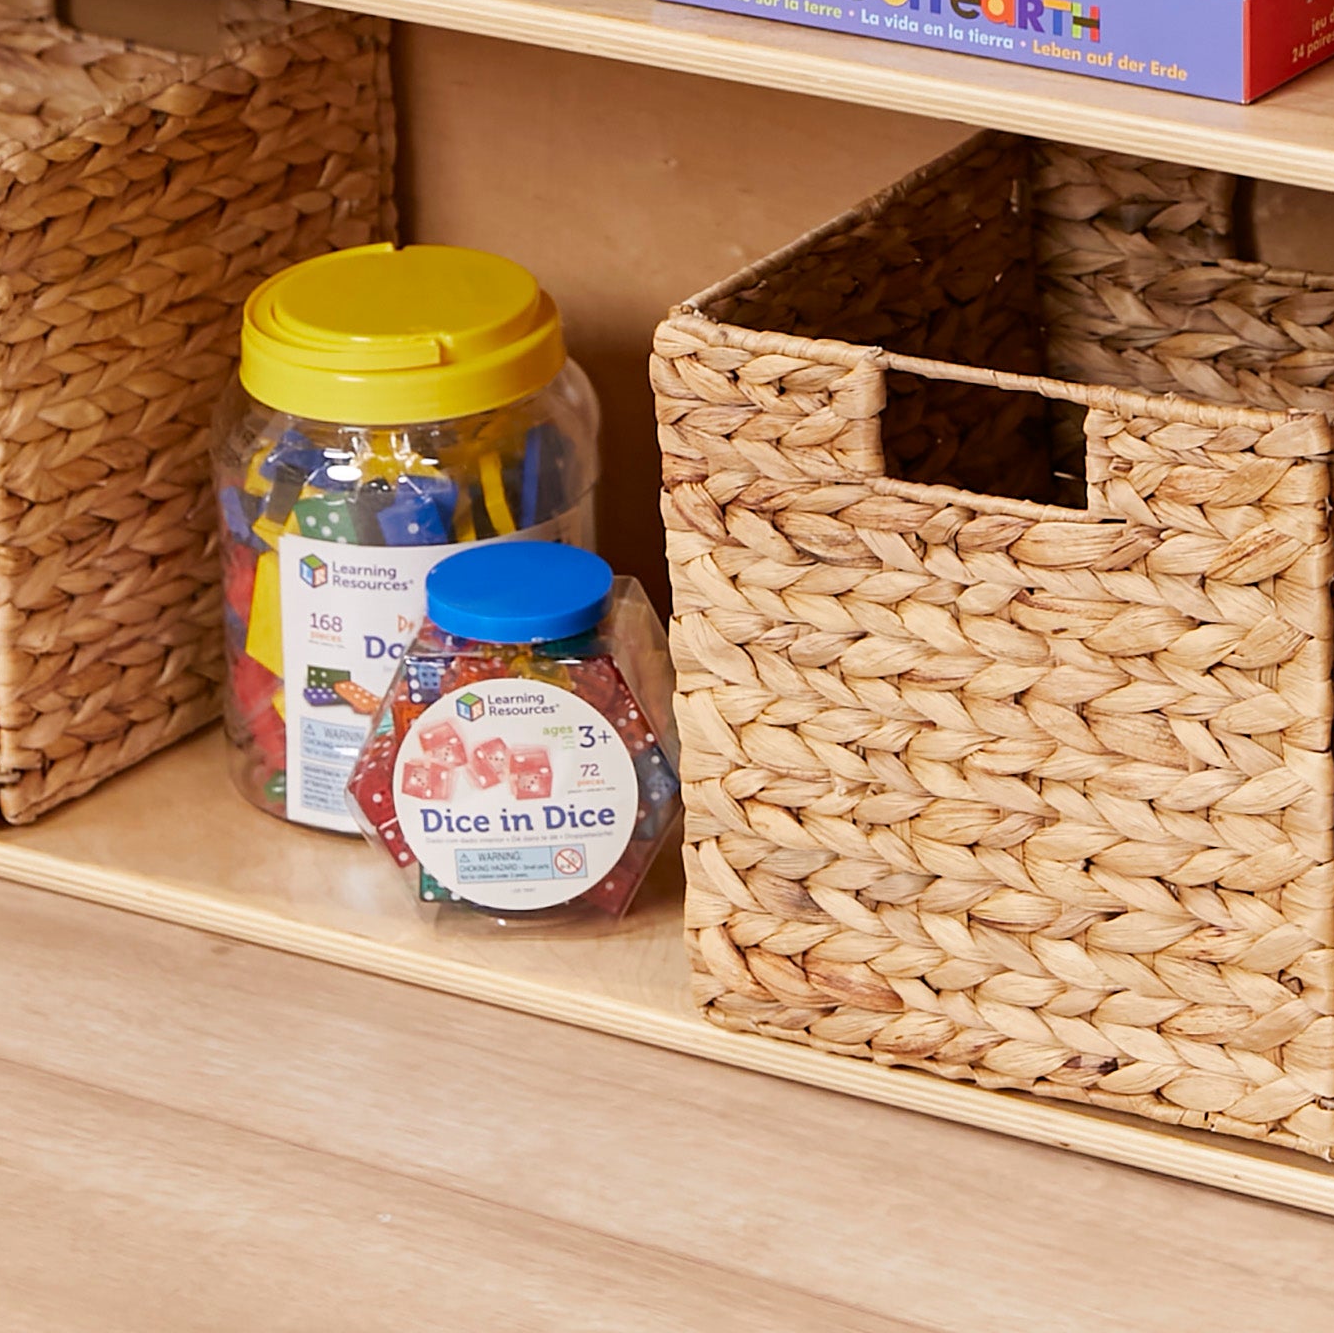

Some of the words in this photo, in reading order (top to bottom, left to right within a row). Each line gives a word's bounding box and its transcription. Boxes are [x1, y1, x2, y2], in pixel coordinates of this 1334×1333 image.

[803, 0, 842, 19] terre
[861, 8, 879, 26] La
[884, 12, 919, 32] vida
[923, 24, 943, 38] en
[948, 23, 964, 40] la
[968, 28, 1014, 49] tierra
[1032, 39, 1082, 62] Leben
[1087, 52, 1113, 67] auf
[1118, 55, 1147, 73] der
[1150, 61, 1188, 81] Erde
[1292, 43, 1305, 63] 24
[332, 561, 397, 580] Learning
[310, 612, 343, 633] 168
[488, 693, 545, 705] Learning
[543, 725, 573, 736] ages
[578, 725, 612, 749] 3+
[580, 763, 601, 778] 72
[420, 808, 491, 833] Dice
[500, 808, 534, 832] in
[543, 804, 616, 830] Dice
